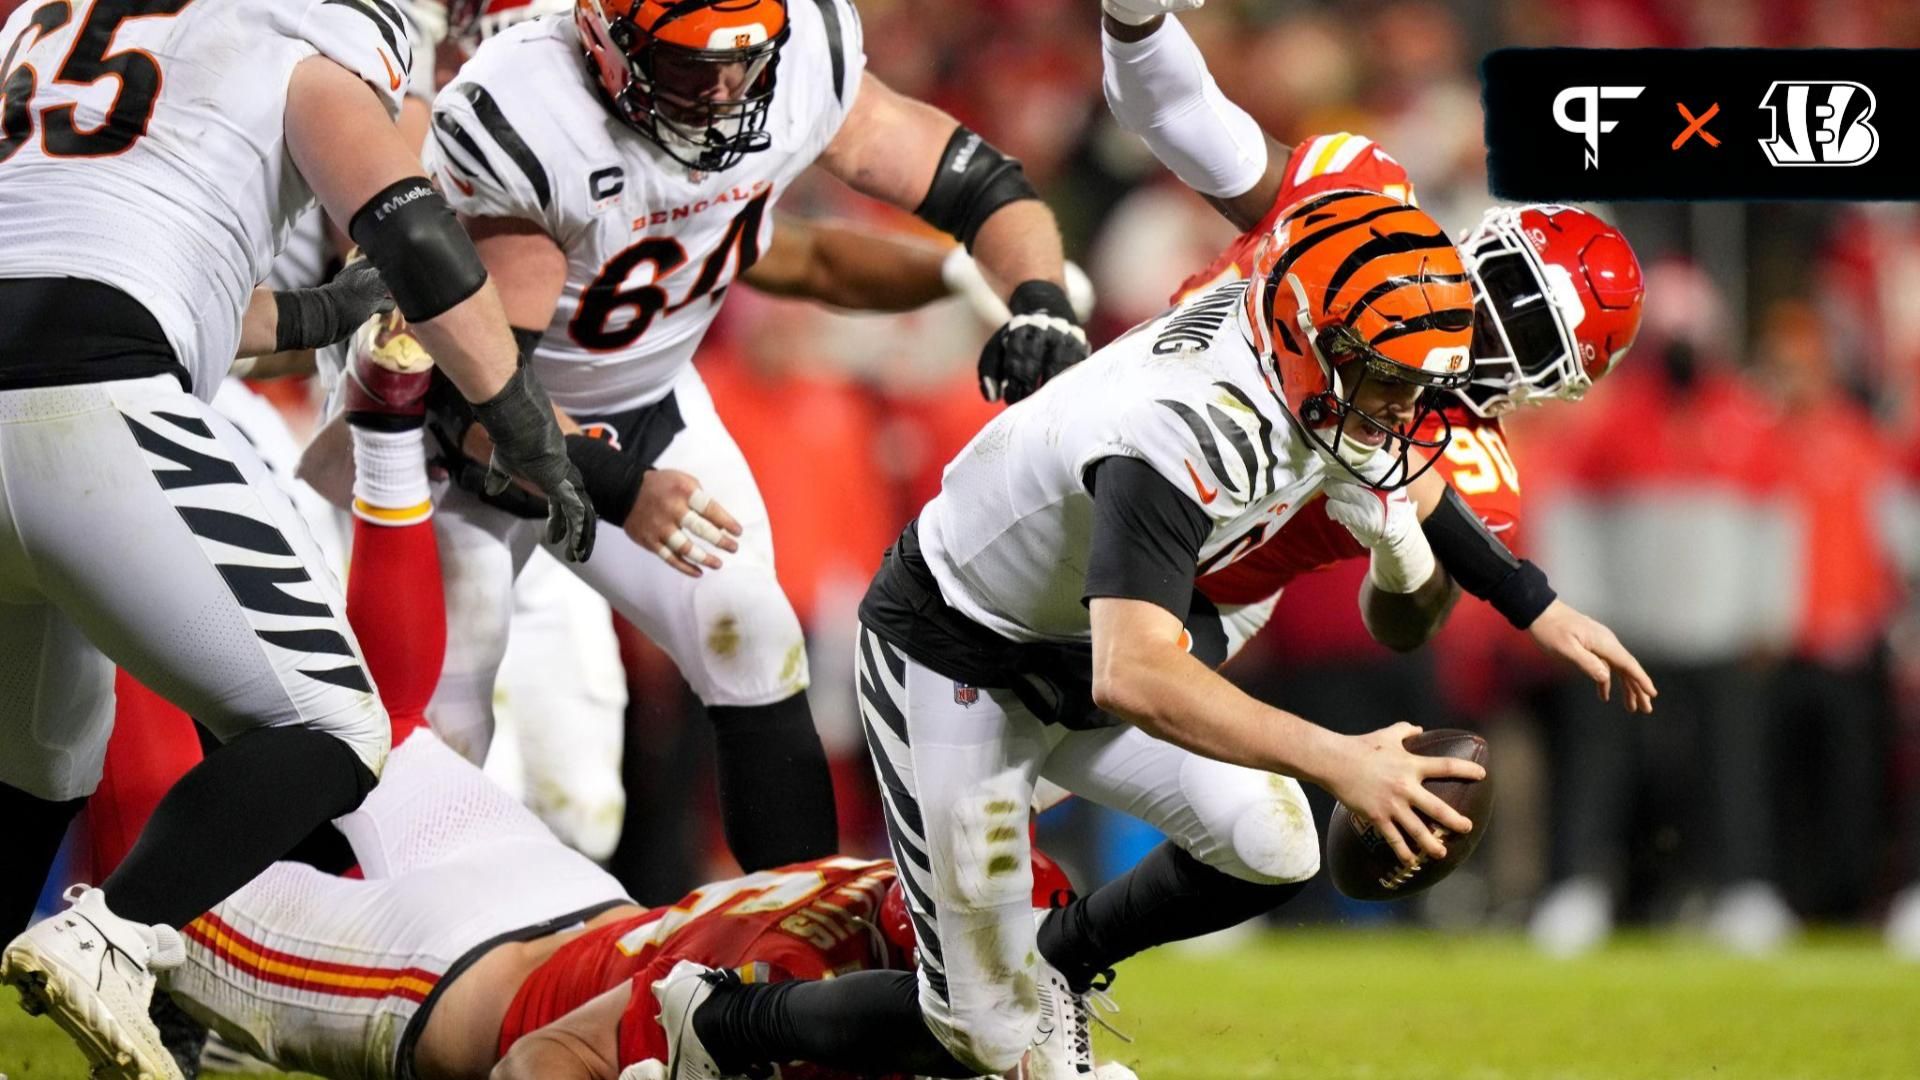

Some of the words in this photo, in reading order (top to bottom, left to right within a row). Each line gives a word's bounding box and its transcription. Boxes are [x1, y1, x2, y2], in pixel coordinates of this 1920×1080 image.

[0, 0, 195, 163] 65
[588, 166, 625, 202] C
[632, 180, 768, 232] BENGALS
[569, 181, 774, 355] 64
[1434, 425, 1520, 496] 90
